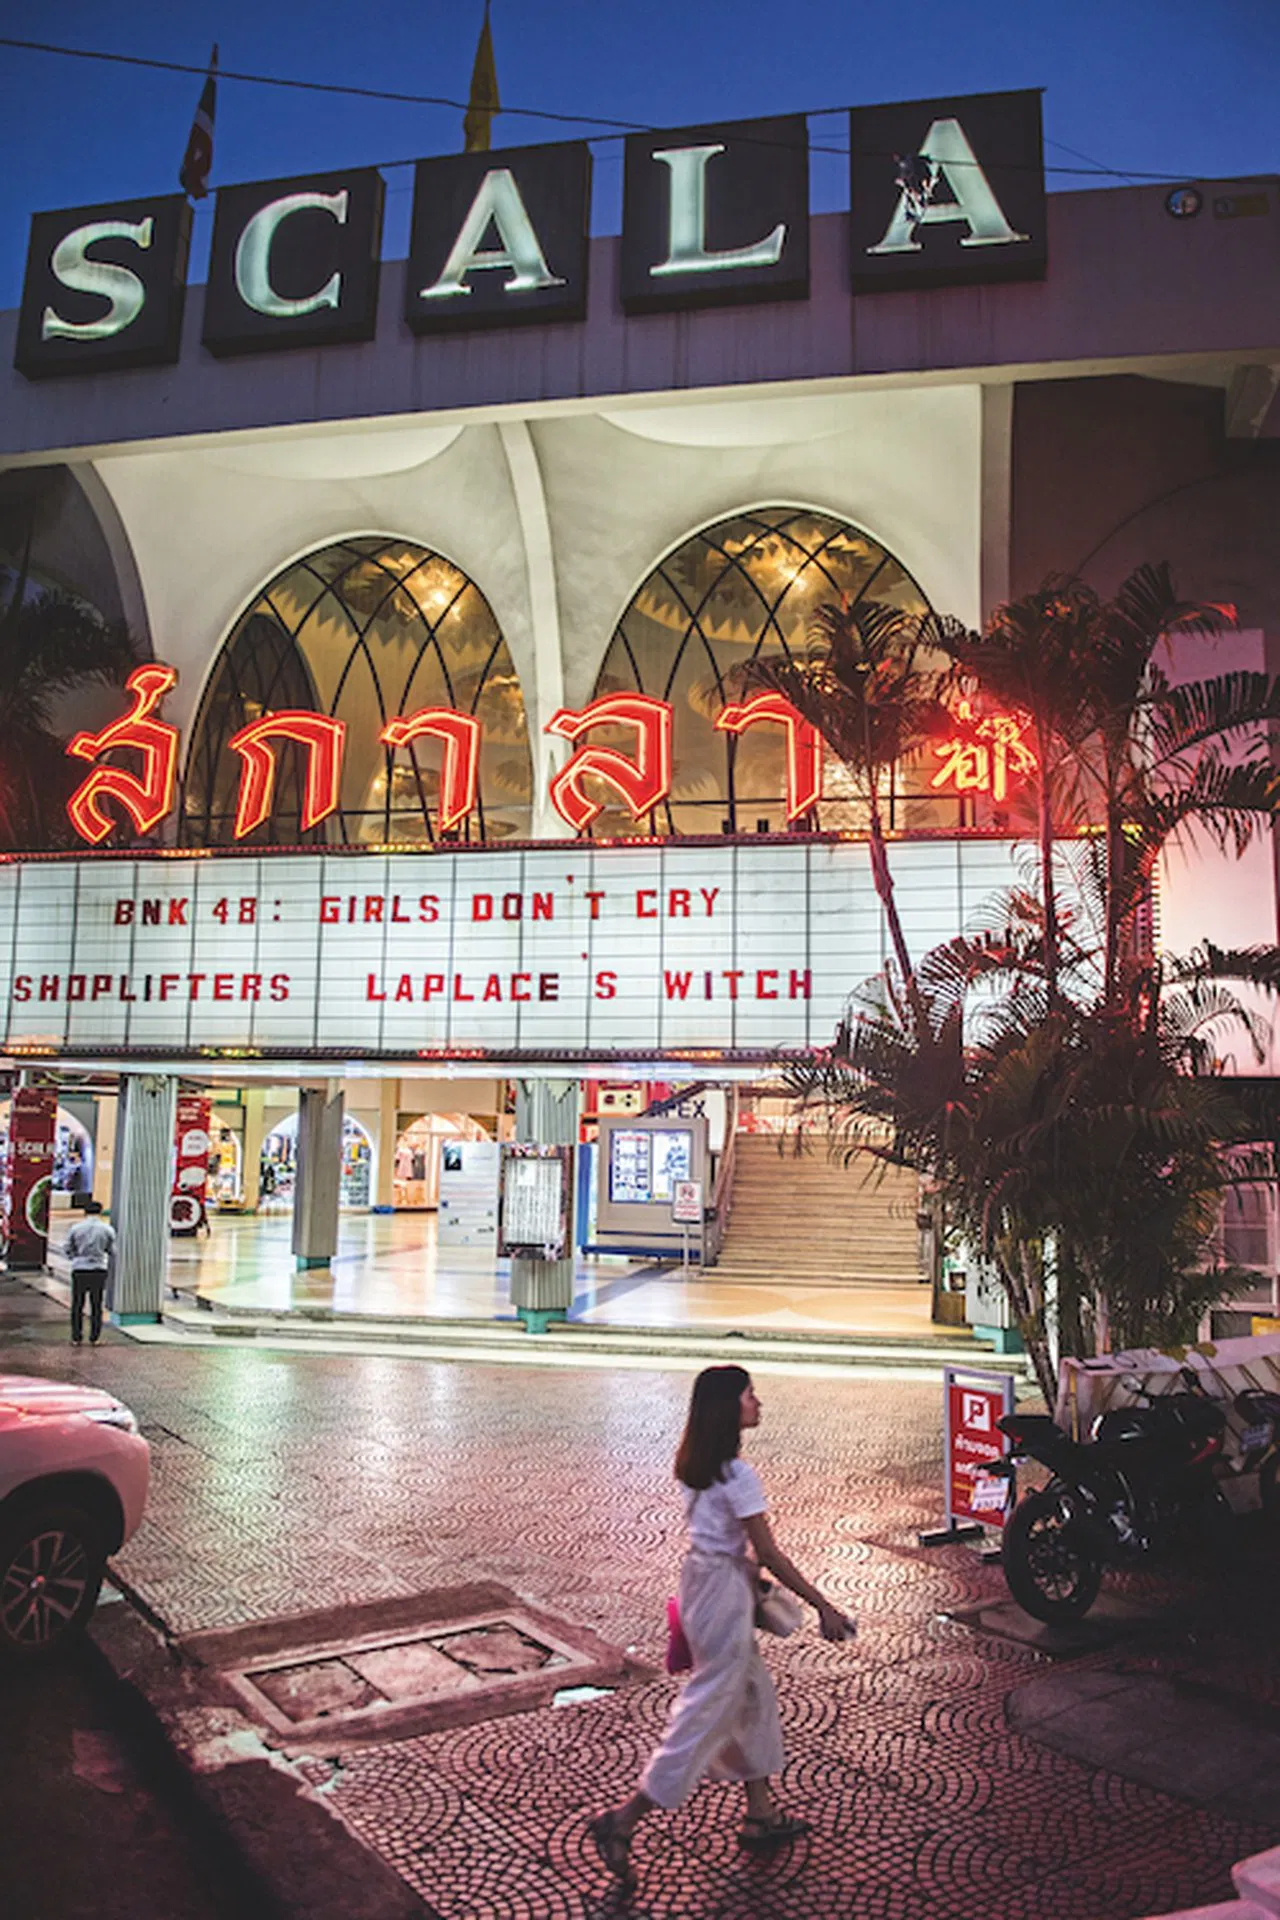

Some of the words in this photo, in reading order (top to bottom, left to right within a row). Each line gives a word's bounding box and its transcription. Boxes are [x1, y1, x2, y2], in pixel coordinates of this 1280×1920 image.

[42, 117, 1030, 341] SCALA
[115, 898, 189, 926] BNK
[212, 897, 283, 924] 48:
[320, 895, 440, 924] GIRLS
[636, 887, 720, 919] CRY
[14, 974, 291, 1002] SHOPLIFTERS
[664, 969, 812, 1001] WITCH
